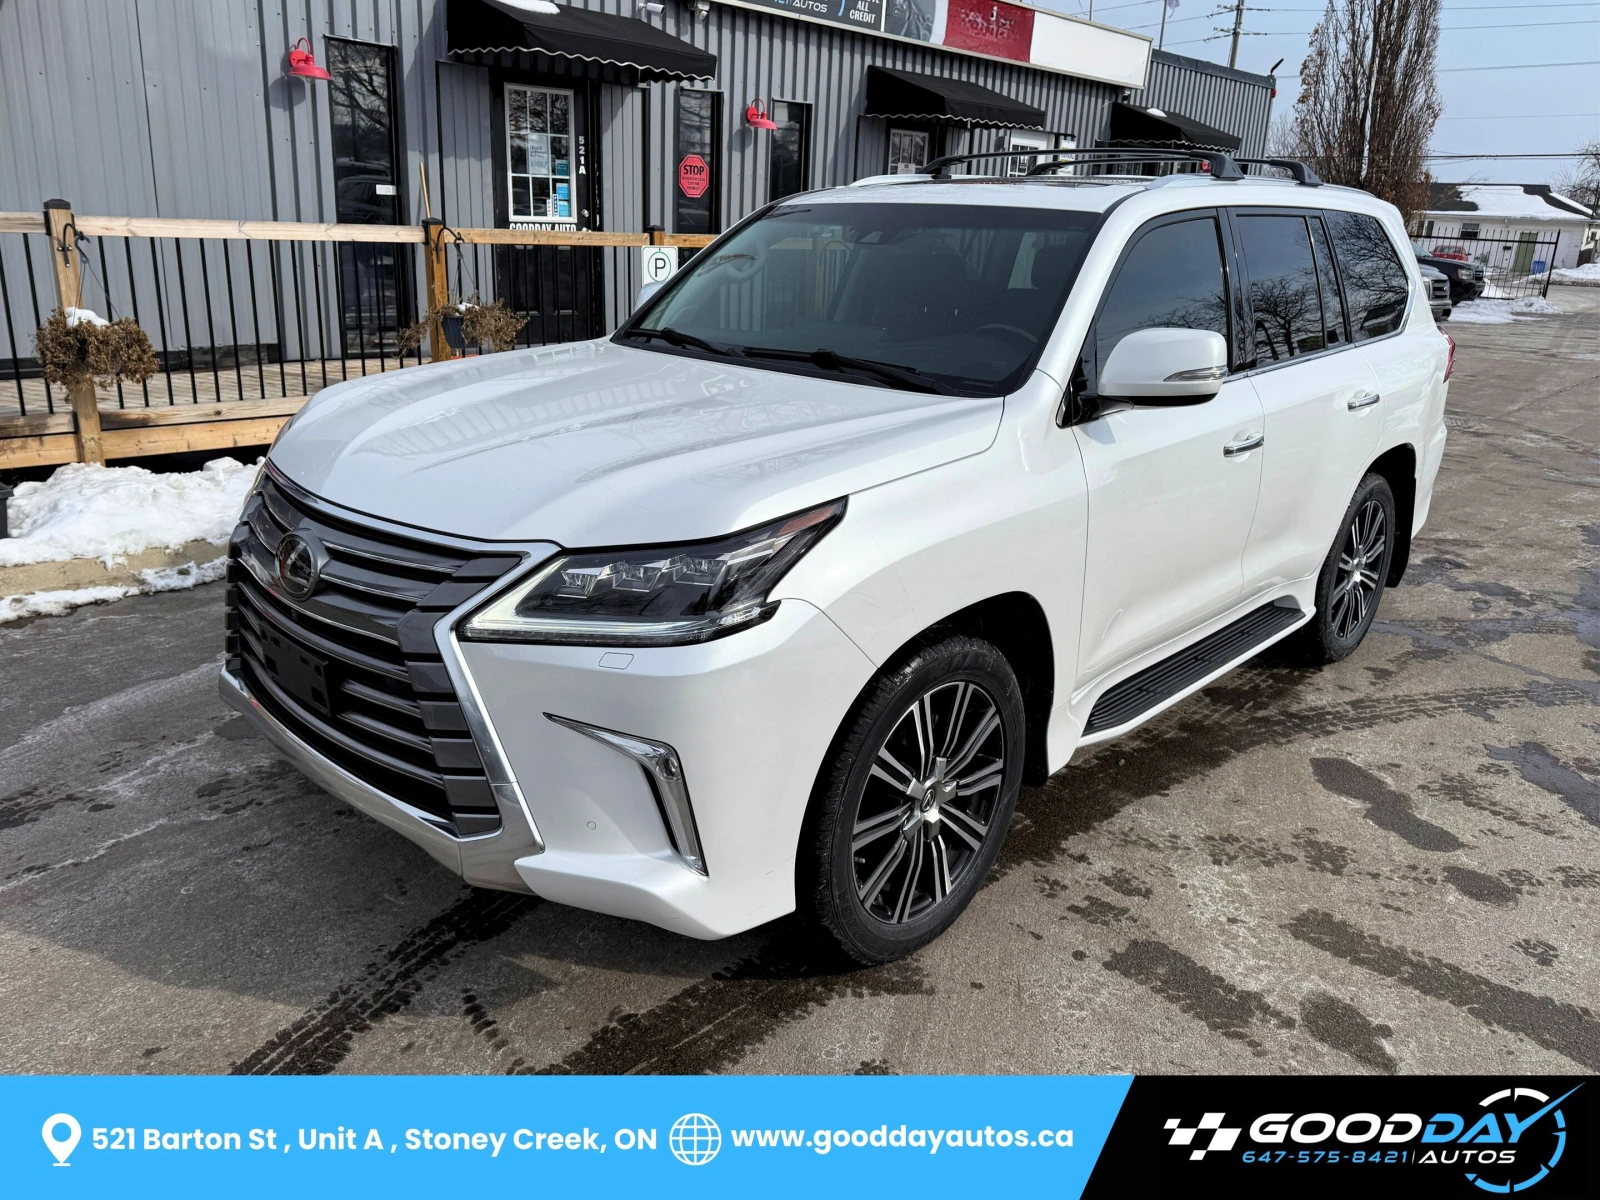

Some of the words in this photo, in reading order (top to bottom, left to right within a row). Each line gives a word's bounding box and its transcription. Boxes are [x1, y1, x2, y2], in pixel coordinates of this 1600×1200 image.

[792, 0, 828, 13] AUTOS
[856, 0, 869, 12] ALL
[849, 9, 876, 24] CREDIT
[683, 164, 705, 176] STOP
[654, 257, 667, 278] P
